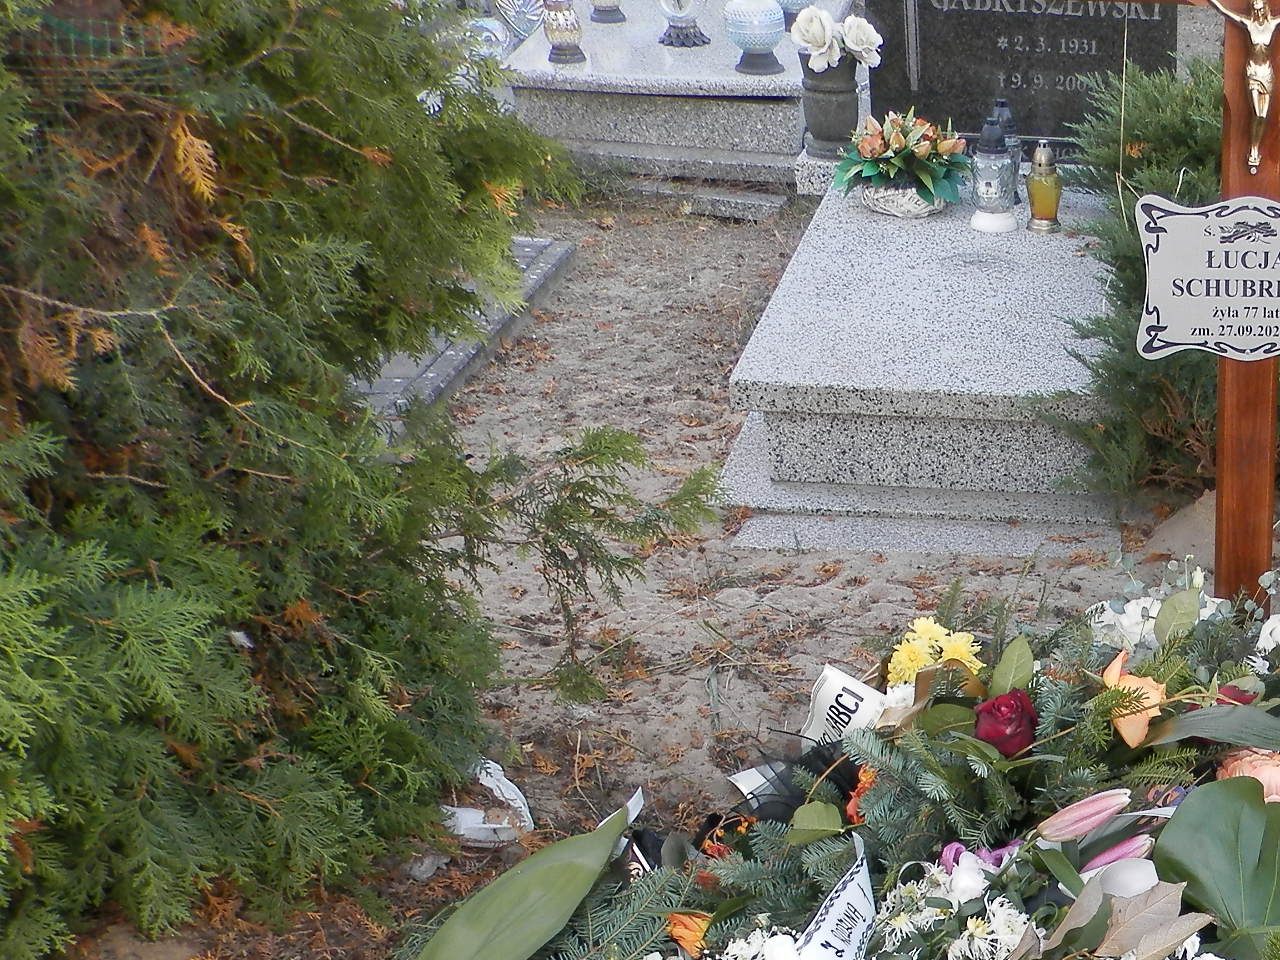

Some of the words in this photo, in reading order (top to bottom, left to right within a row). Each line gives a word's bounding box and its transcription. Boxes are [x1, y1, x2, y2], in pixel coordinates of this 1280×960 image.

[1060, 38, 1097, 55] 1931
[1056, 75, 1088, 92] 200
[1204, 225, 1216, 237] Ś.
[1212, 306, 1239, 321] żyła
[1243, 307, 1258, 319] 77
[1263, 307, 1280, 319] lat
[1190, 327, 1214, 337] zm.
